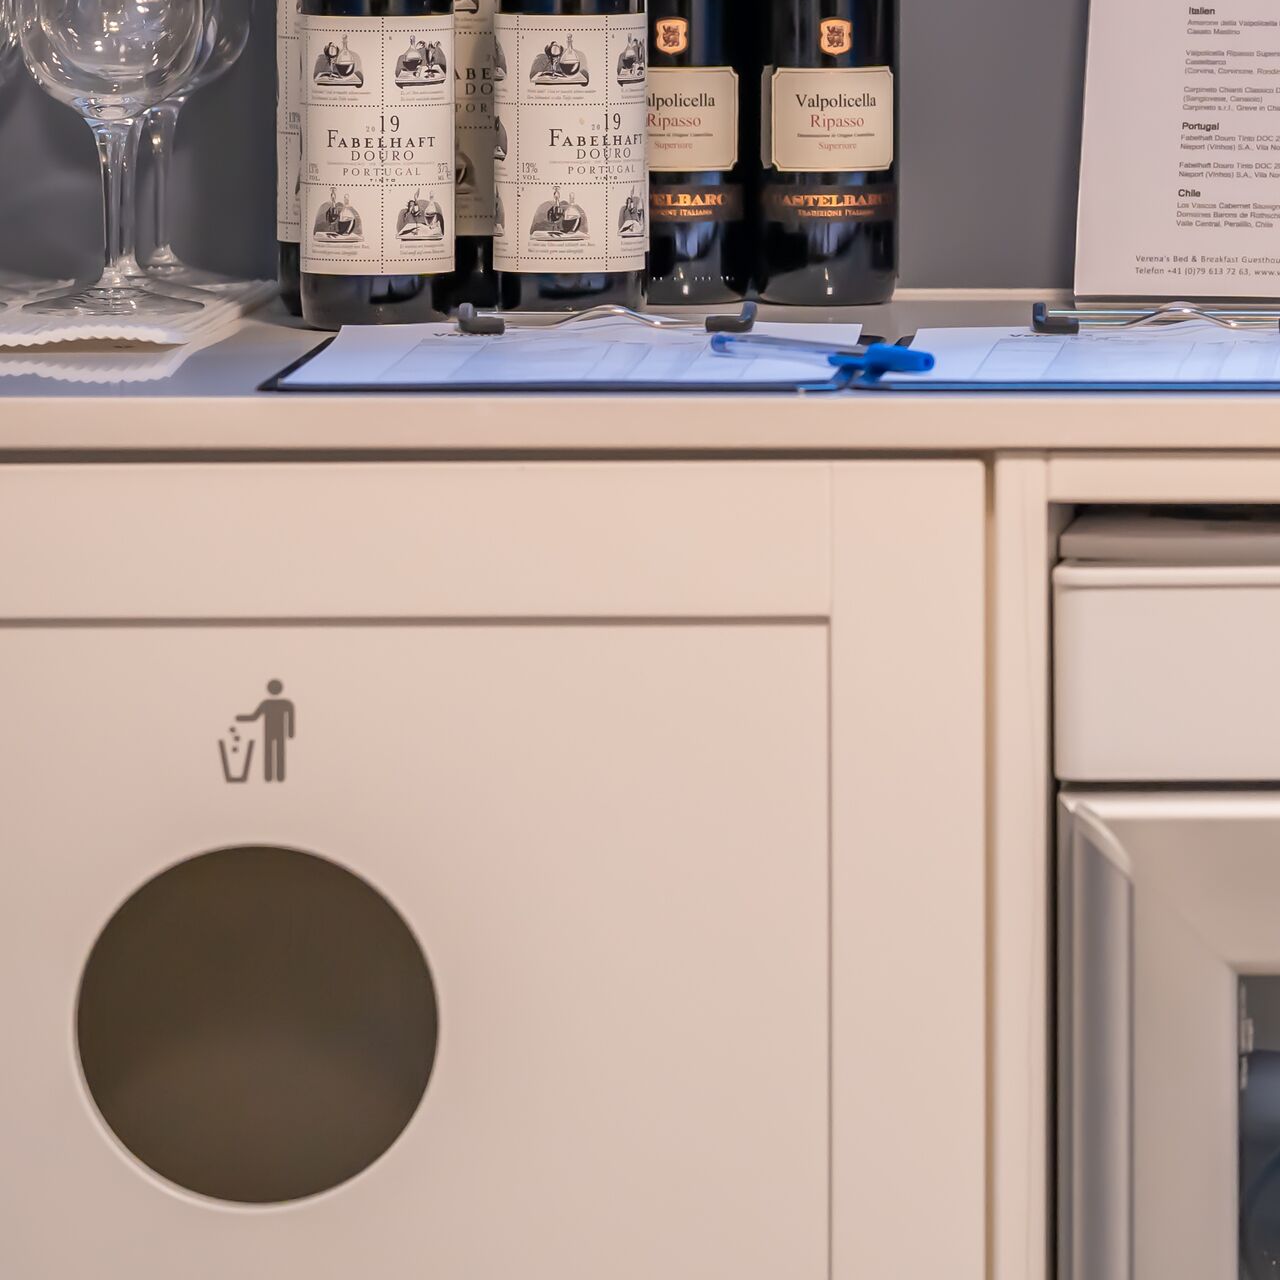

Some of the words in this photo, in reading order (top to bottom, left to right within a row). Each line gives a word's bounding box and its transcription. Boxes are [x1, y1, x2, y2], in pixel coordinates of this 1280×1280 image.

[1189, 7, 1215, 15] Italien
[646, 93, 715, 111] lpolicella
[795, 93, 877, 112] Valpolicella
[379, 115, 400, 133] 19
[604, 113, 621, 131] 19
[647, 113, 701, 131] Ripasso
[810, 114, 865, 131] Ripasso
[1182, 122, 1220, 132] Portugal
[327, 129, 436, 149] FABELHAFT
[549, 128, 643, 147] FABELHAFT
[351, 150, 414, 162] DOURO
[576, 147, 631, 160] DOURO
[342, 167, 422, 177] PORTUGAL
[521, 162, 538, 174] 13%
[568, 164, 636, 175] PORTUGAL
[1178, 189, 1201, 197] Chile
[783, 193, 881, 207] ASTELBAR
[1135, 255, 1170, 263] Verena's
[1173, 255, 1189, 263] Bed
[1201, 255, 1239, 263] Breakfast
[1135, 266, 1164, 275] Telefon
[1167, 267, 1181, 275] +41
[1184, 267, 1206, 276] (0)79
[1207, 267, 1223, 275] 613
[1239, 268, 1251, 276] 63,
